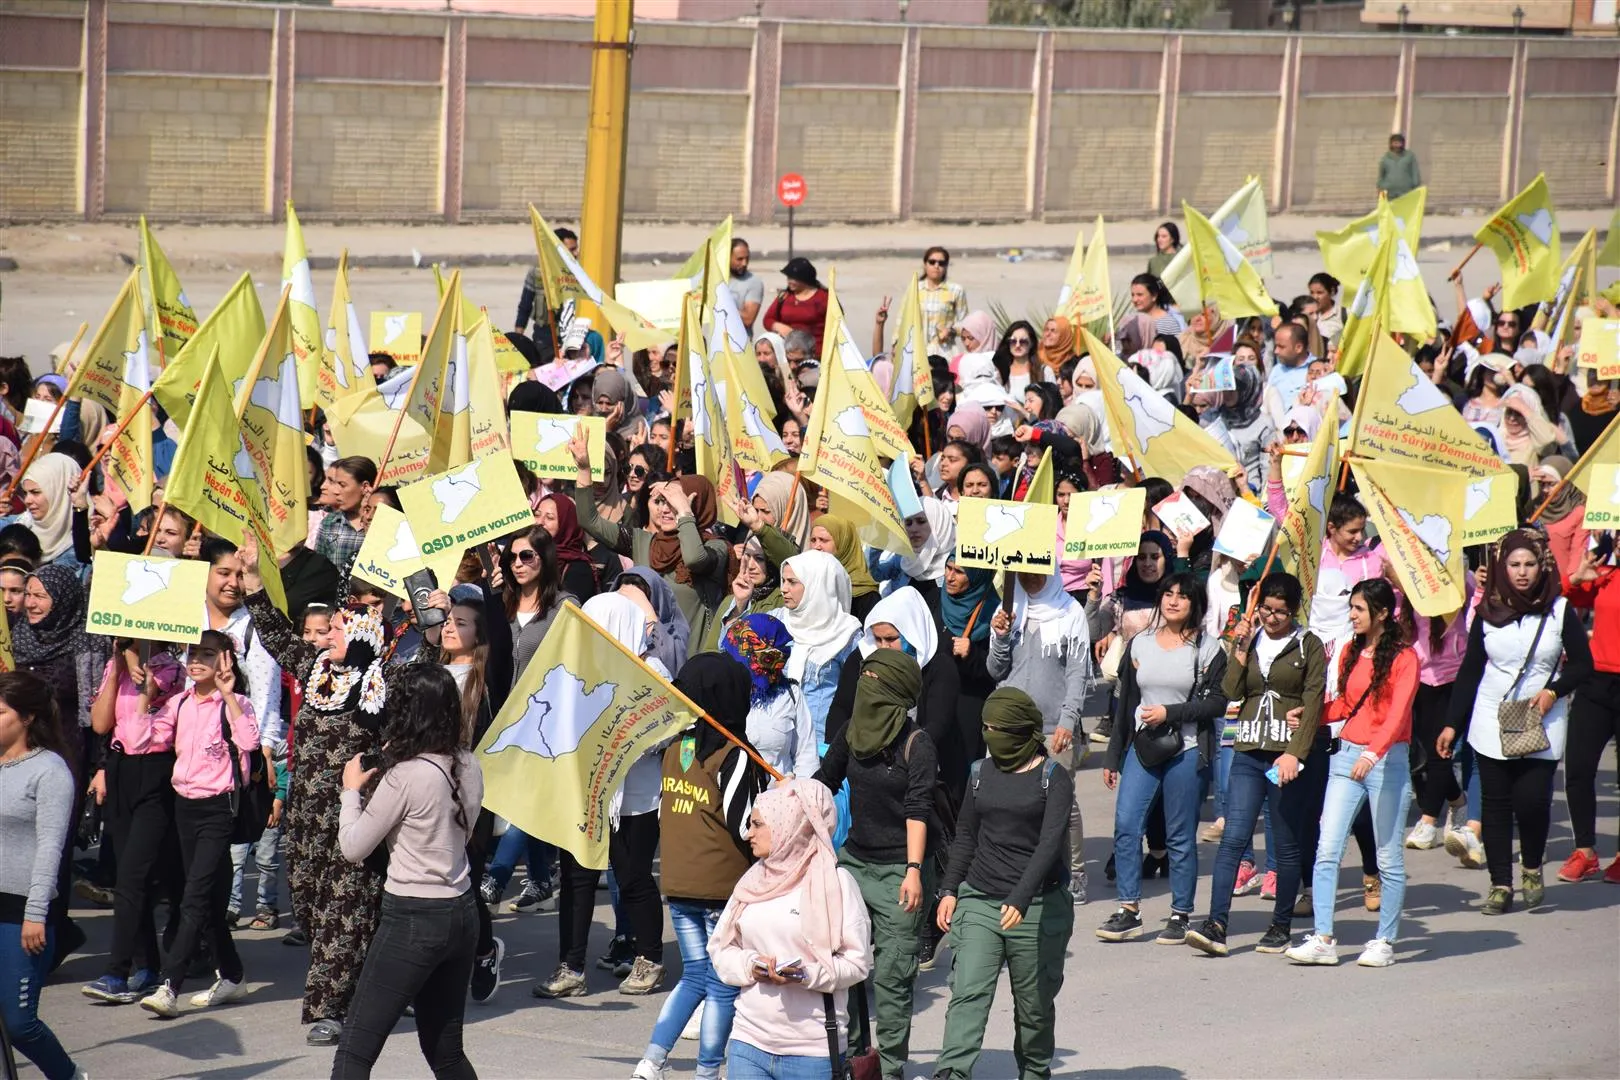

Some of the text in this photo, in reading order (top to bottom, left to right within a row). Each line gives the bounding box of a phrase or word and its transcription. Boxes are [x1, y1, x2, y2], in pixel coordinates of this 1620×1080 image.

[549, 464, 566, 473] OUR
[1586, 511, 1611, 522] QSD
[421, 509, 531, 555] QSD IS OUR VOLITION
[1065, 541, 1086, 553] QSD
[1094, 543, 1108, 551] OUR
[1109, 541, 1137, 550] VOLITION
[961, 543, 1051, 569] قسد هي إرادتنا
[91, 611, 199, 635] QSD IS OUR VOLITION
[671, 798, 695, 815] JIN
